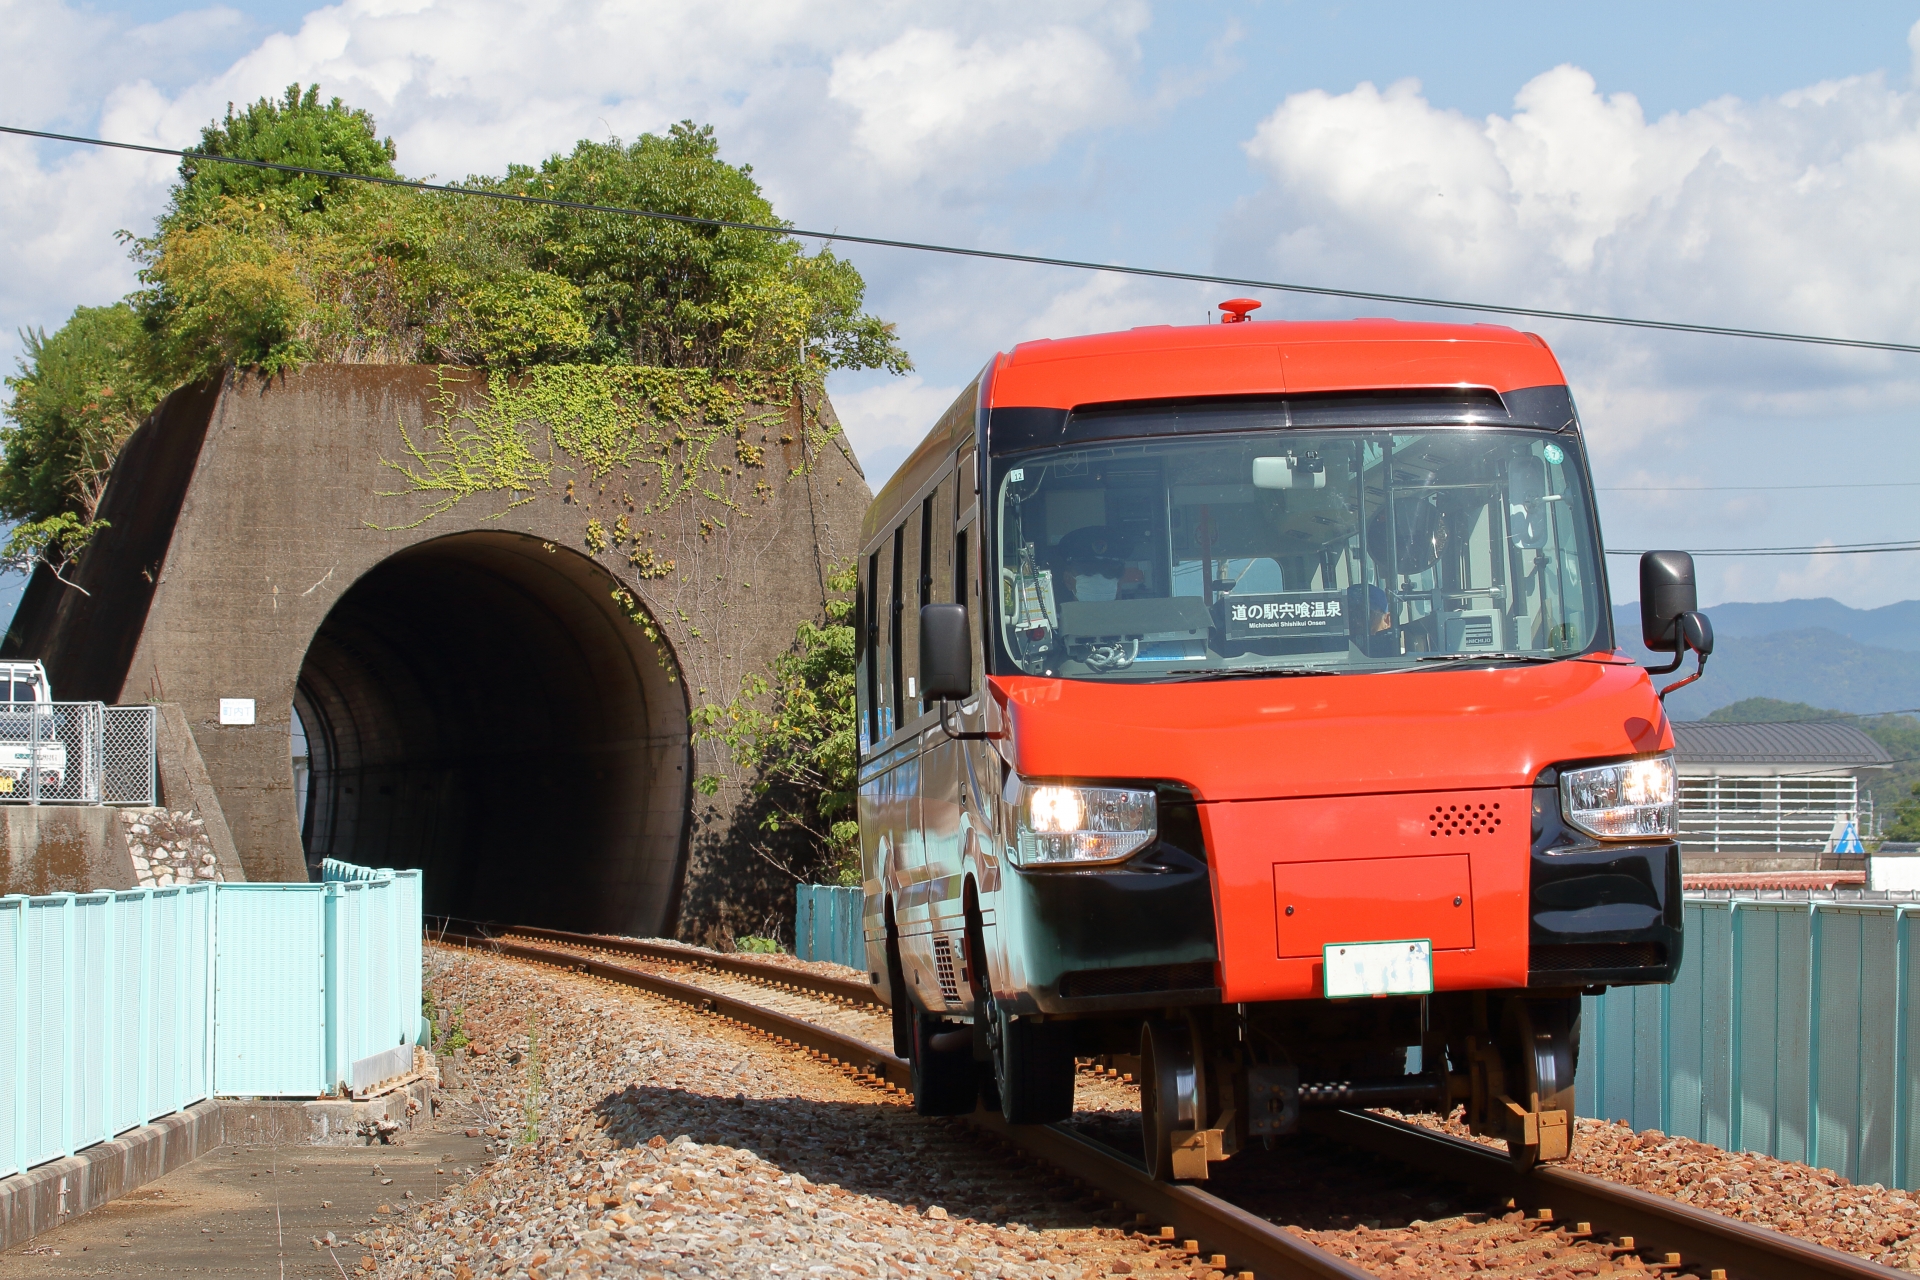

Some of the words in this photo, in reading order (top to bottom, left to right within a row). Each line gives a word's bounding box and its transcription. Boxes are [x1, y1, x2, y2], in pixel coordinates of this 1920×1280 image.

[1014, 472, 1023, 480] 12
[1231, 600, 1342, 621] 道の駅宍喰温泉
[1280, 620, 1307, 628] Shishikui
[1307, 619, 1326, 627] Onsen
